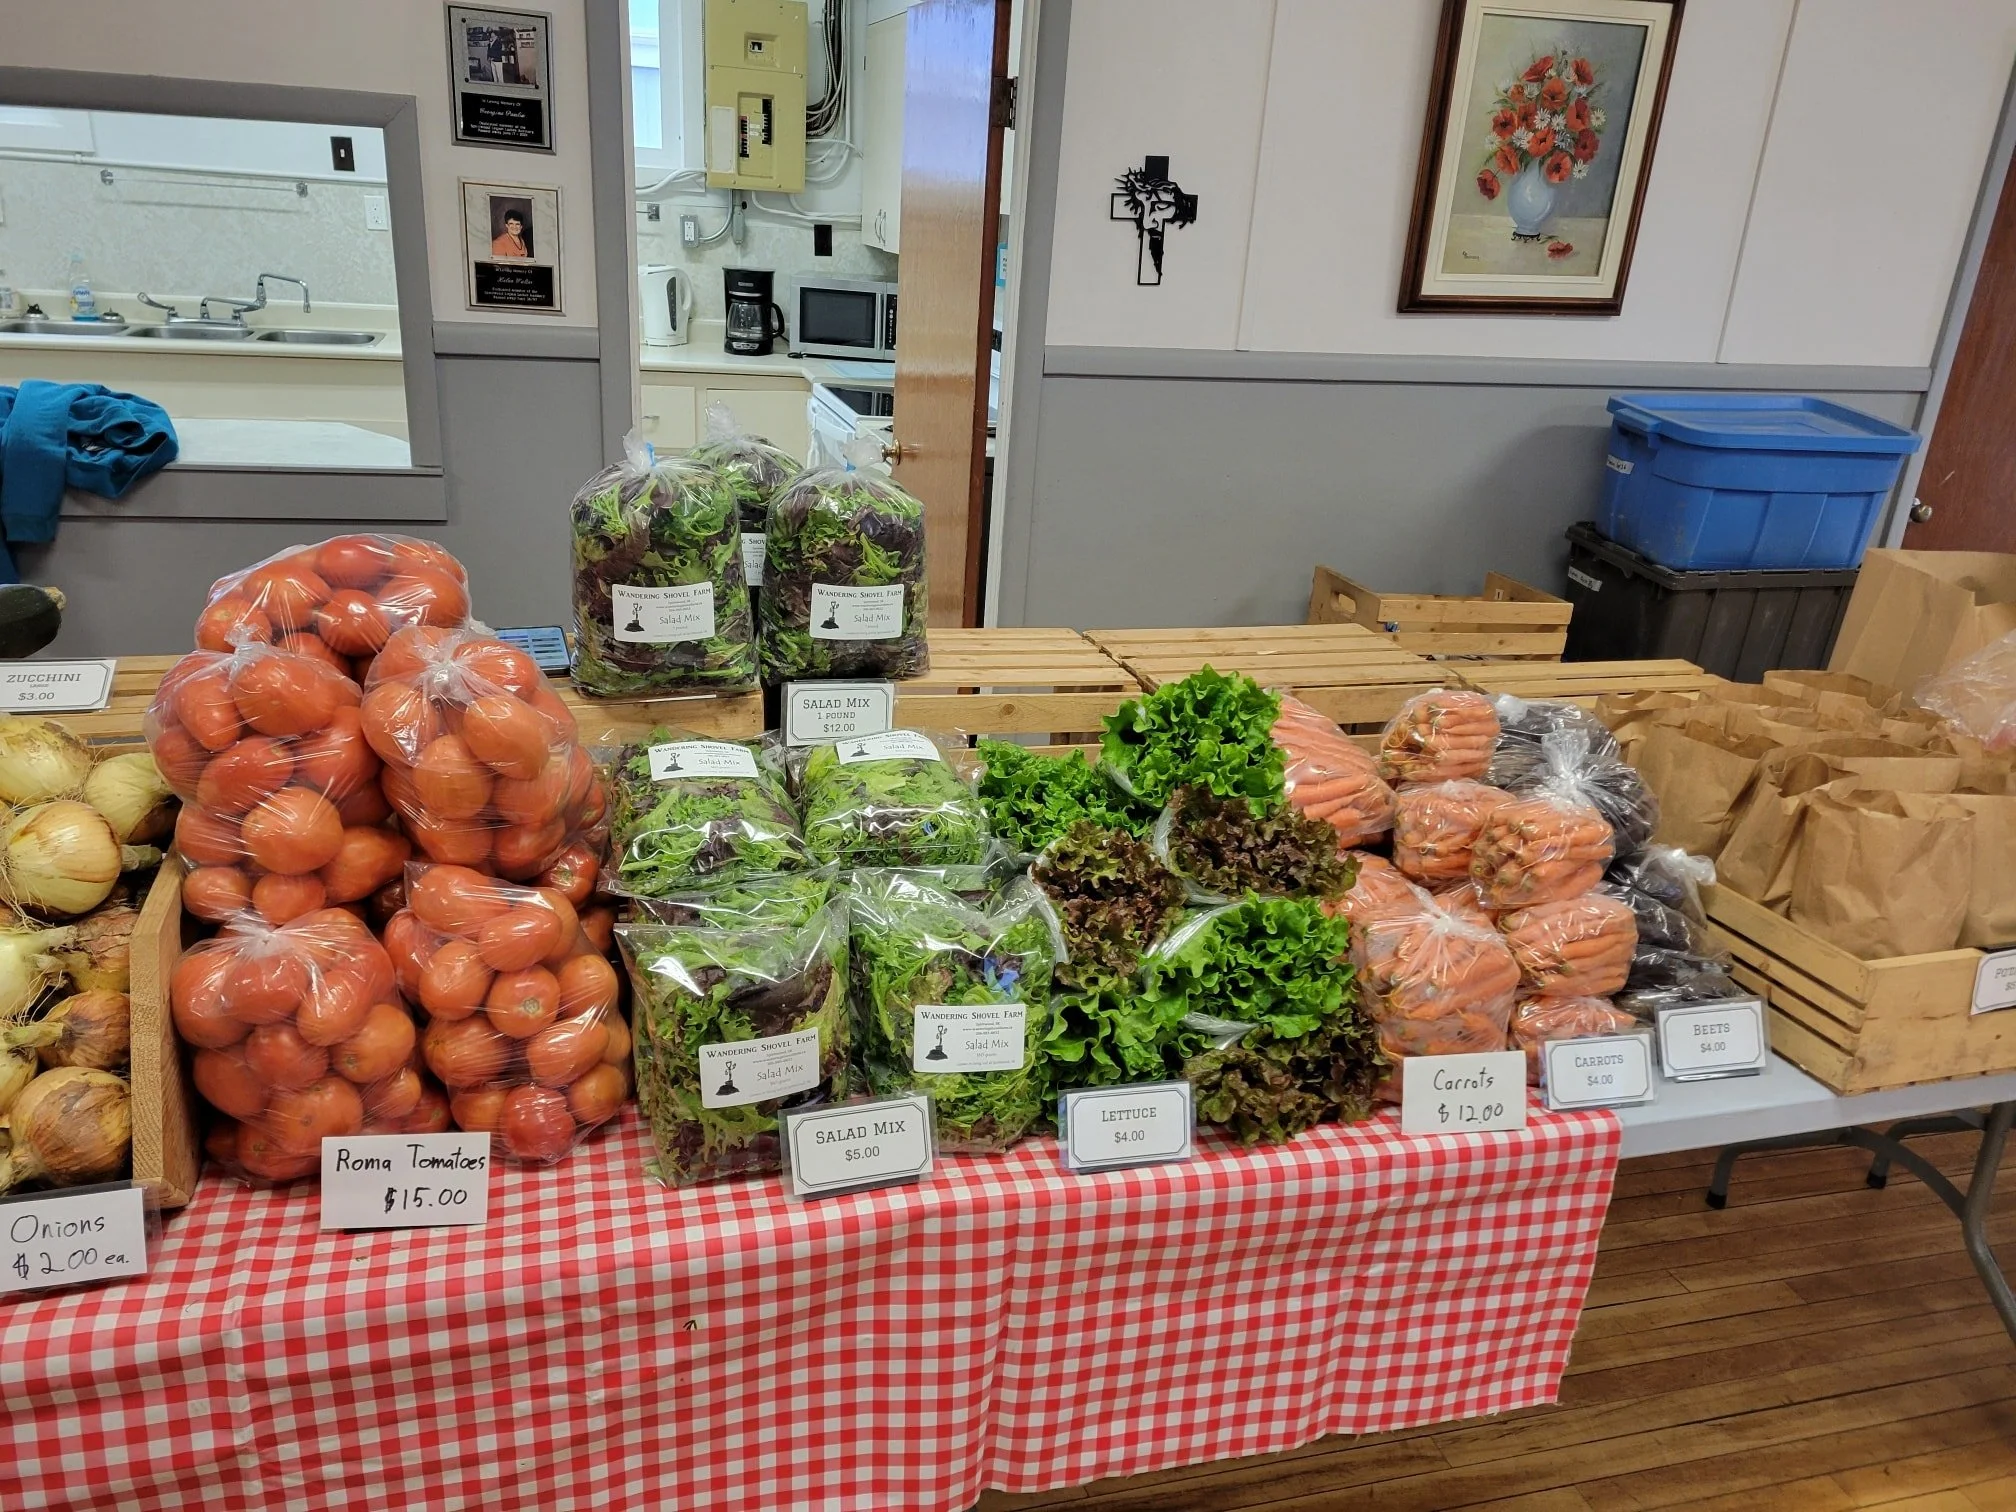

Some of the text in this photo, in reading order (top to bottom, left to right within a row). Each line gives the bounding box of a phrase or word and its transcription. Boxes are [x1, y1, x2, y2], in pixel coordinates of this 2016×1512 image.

[618, 587, 711, 599] WANDERING SHOVEL FARM
[817, 588, 857, 599] WANDERING
[886, 589, 902, 597] FARM
[659, 614, 701, 625] Salad Mix
[854, 614, 891, 623] Salad Mix
[6, 673, 82, 683] ZUCCHINI
[18, 692, 55, 701] $3.00
[803, 697, 871, 710] SALAD MIX
[817, 711, 856, 720] 1 POUND
[823, 723, 856, 733] $12.00
[654, 745, 698, 753] WANDERING
[921, 1011, 968, 1020] WANDERING
[1004, 1010, 1023, 1018] FARM
[1693, 1023, 1731, 1036] BEETS
[706, 1047, 757, 1058] WANDERING
[761, 1041, 792, 1051] SHOVEL
[796, 1034, 816, 1045] FARM
[965, 1039, 1009, 1050] Salad Mix
[1700, 1041, 1726, 1053] $4.00
[1574, 1054, 1624, 1068] CARROTS
[757, 1064, 804, 1081] Salad Mix
[1433, 1067, 1494, 1091] Carrots
[1587, 1075, 1614, 1087] $4.00
[1101, 1107, 1157, 1122] LETTUCE
[815, 1120, 906, 1145] SALAD MIX
[1114, 1130, 1145, 1144] $4.00
[336, 1143, 486, 1172] Roma Tomatoes
[845, 1145, 881, 1162] $5.00
[384, 1186, 468, 1214] $15.00
[10, 1214, 105, 1243] Onions
